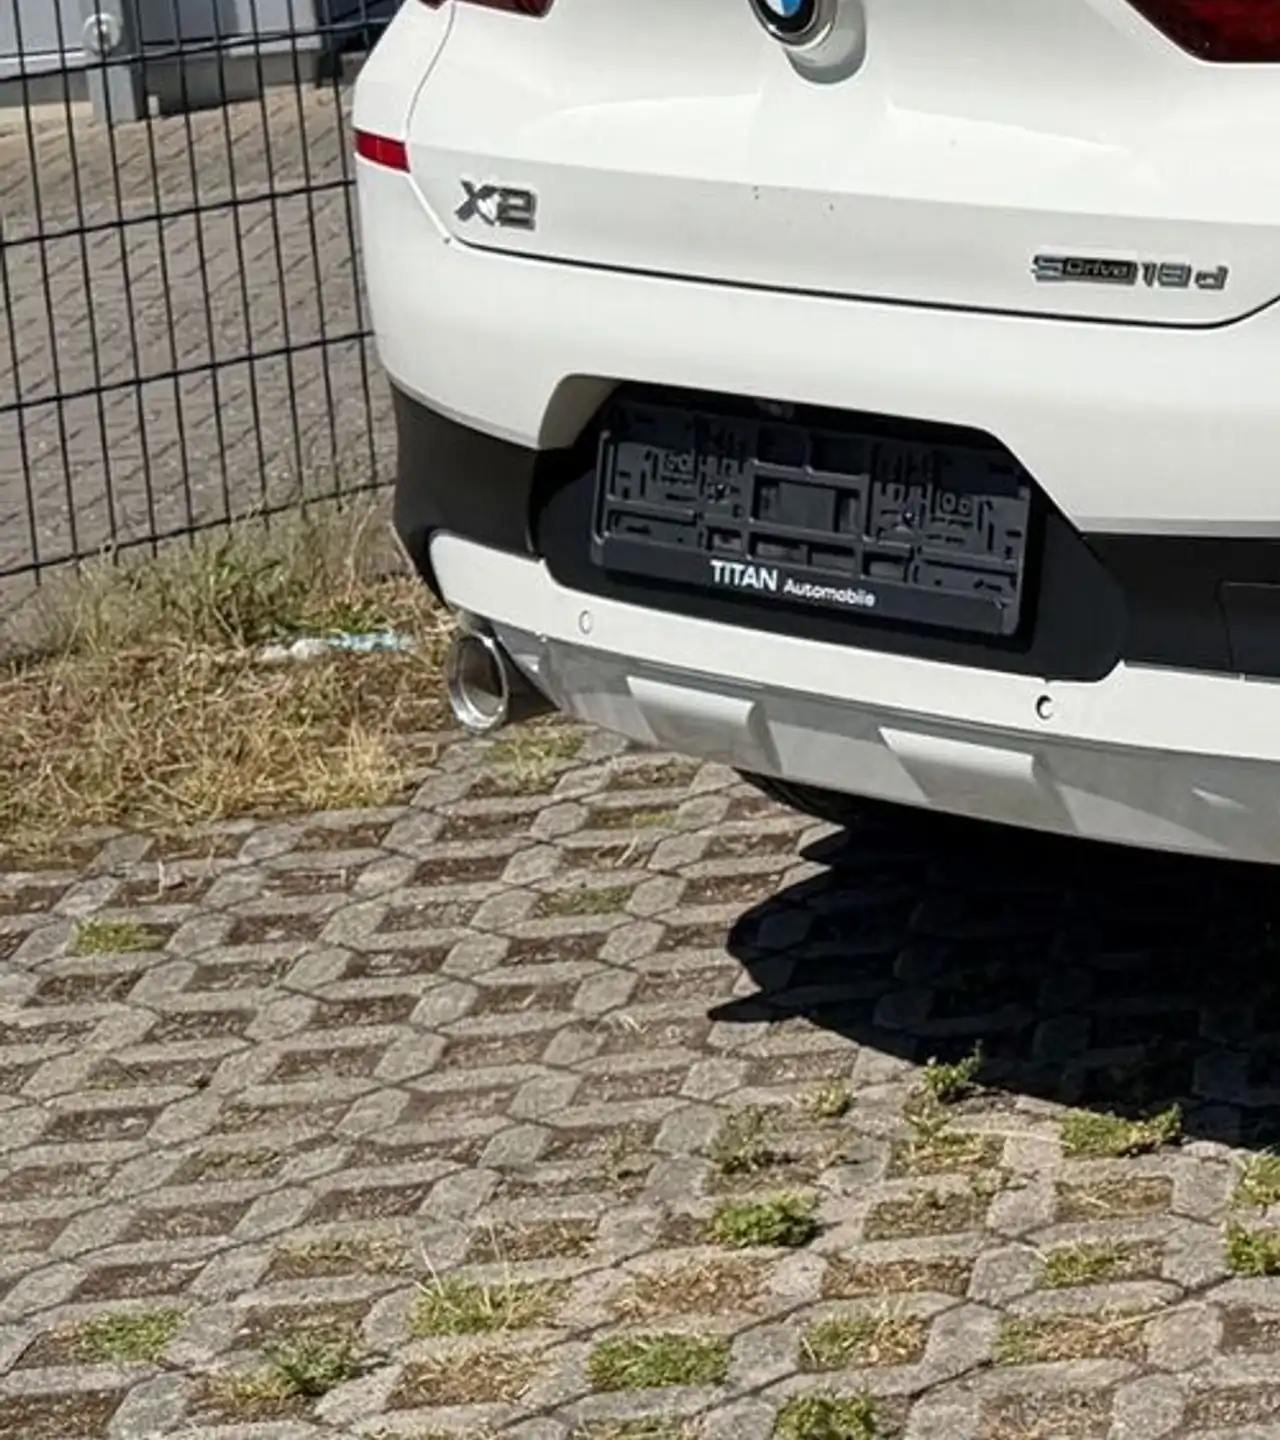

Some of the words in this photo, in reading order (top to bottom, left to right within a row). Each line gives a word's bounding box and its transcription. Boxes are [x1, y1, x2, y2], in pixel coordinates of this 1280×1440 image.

[454, 179, 537, 231] X2
[709, 559, 778, 592] TITAN
[783, 577, 876, 608] Automobile
